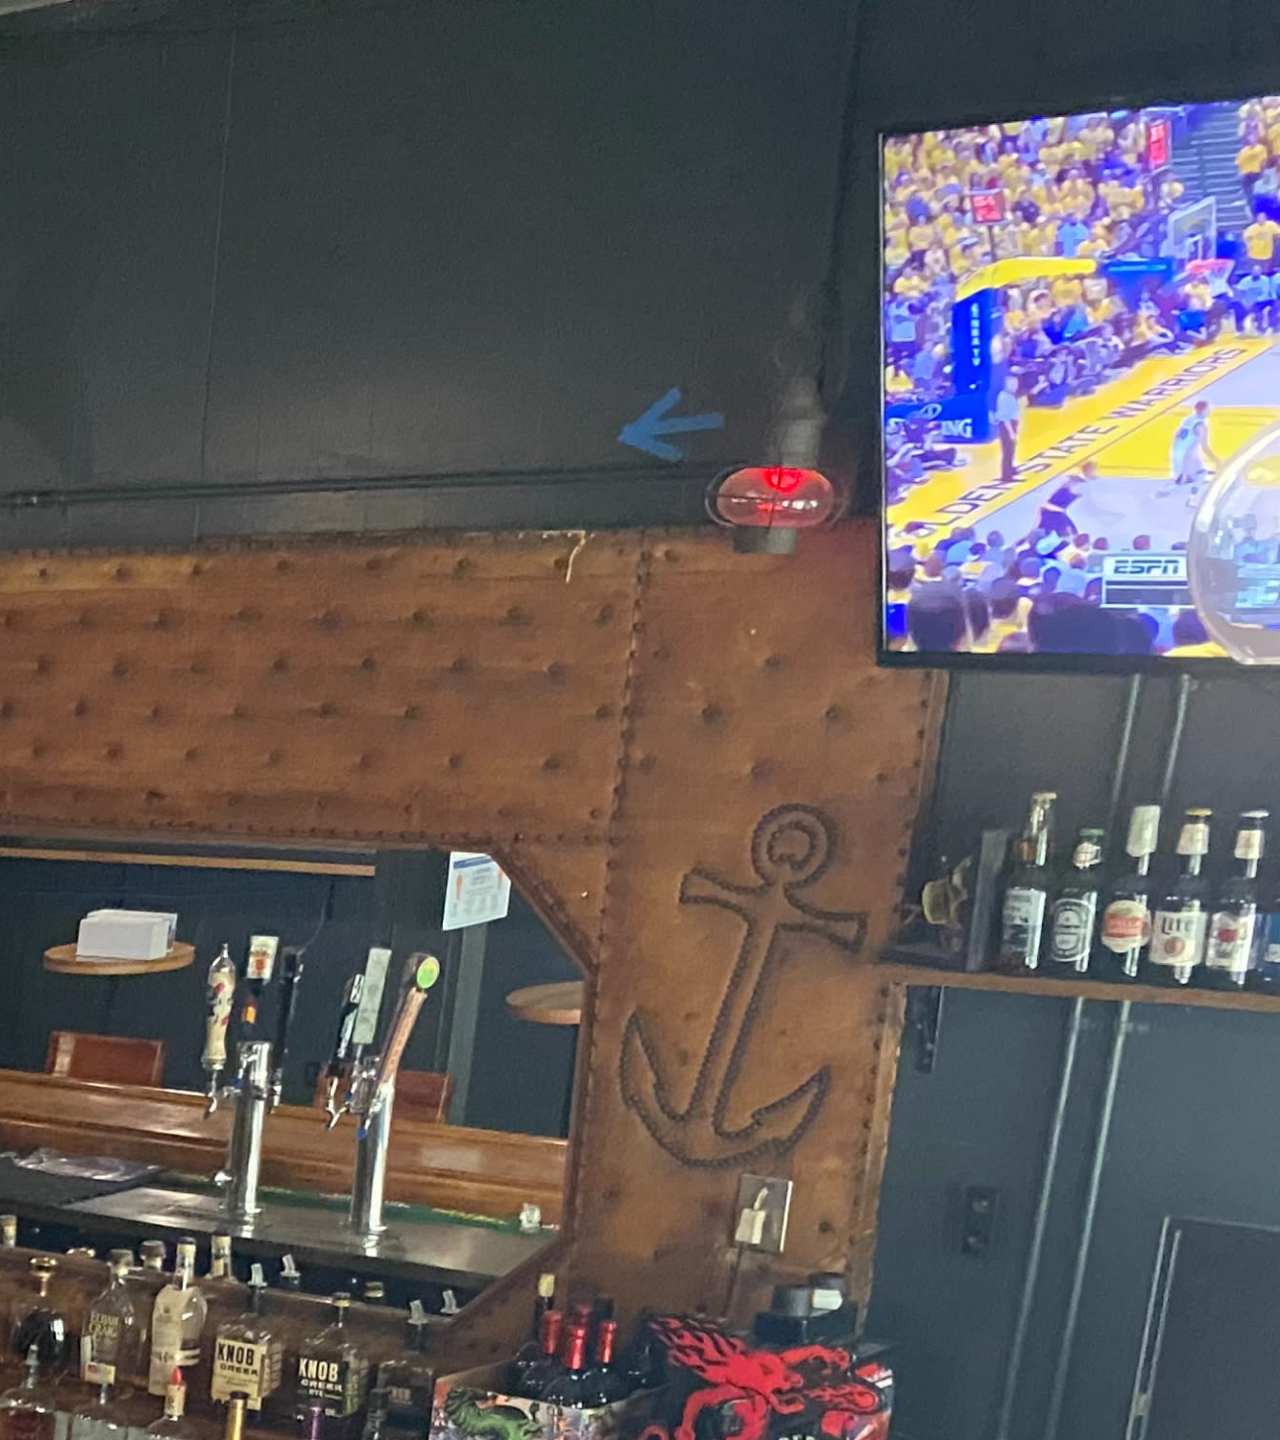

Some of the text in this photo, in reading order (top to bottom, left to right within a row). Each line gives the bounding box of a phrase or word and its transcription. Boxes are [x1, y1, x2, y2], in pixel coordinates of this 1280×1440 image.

[1015, 423, 1119, 474] STATE
[1101, 346, 1248, 421] WARRIORS
[1113, 559, 1179, 575] ESPN
[217, 1342, 255, 1366] KNOB
[299, 1357, 339, 1382] KNOB
